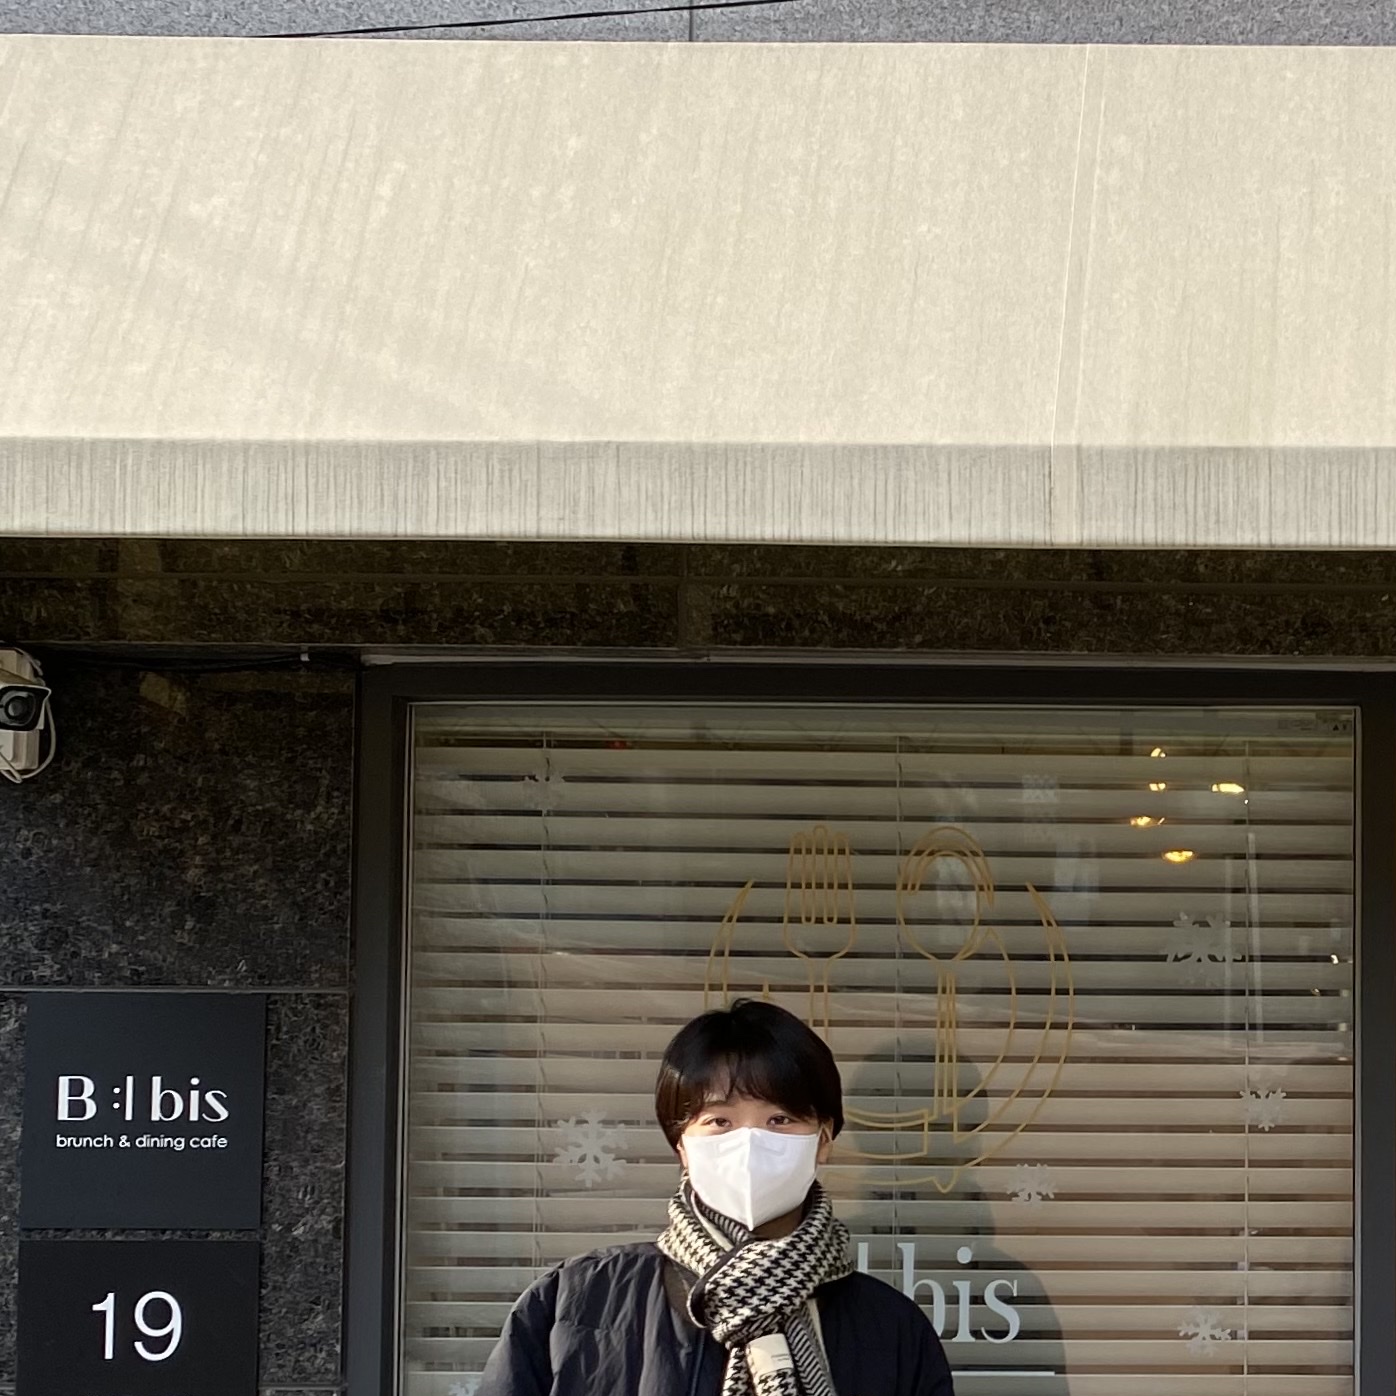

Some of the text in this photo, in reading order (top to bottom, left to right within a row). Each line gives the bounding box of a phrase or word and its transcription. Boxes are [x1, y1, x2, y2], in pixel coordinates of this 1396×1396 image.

[150, 1075, 229, 1123] bis
[56, 1134, 228, 1151] brunch & dining cafe
[92, 1291, 183, 1362] 19
